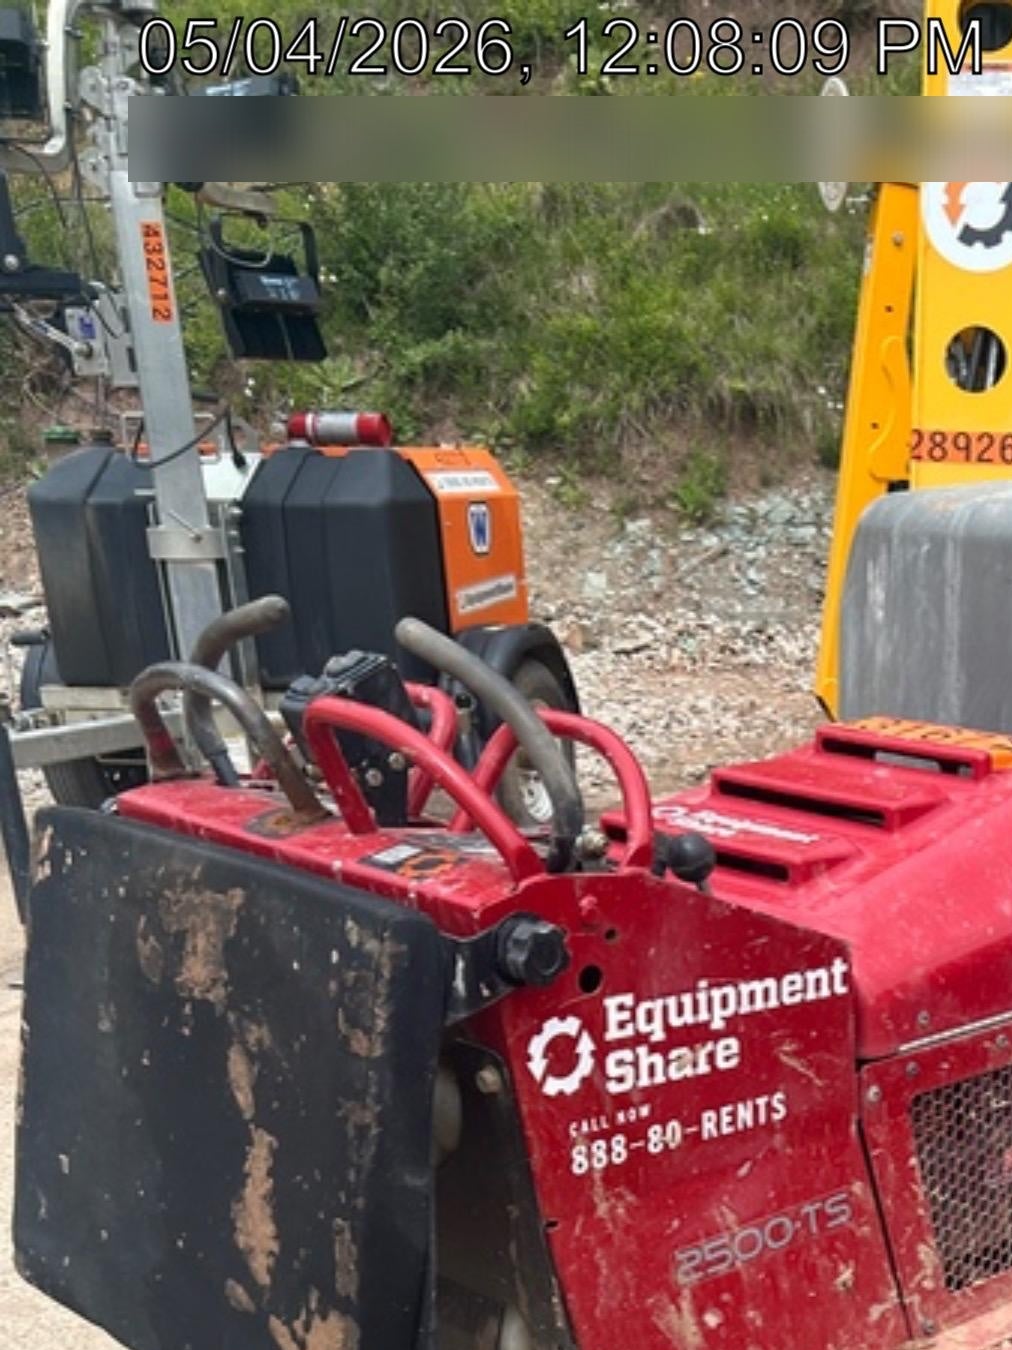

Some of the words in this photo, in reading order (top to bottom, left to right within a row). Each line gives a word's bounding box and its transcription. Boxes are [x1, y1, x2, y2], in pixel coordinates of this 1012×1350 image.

[603, 957, 848, 1042] Equipment
[604, 1036, 740, 1094] Share
[568, 1114, 610, 1139] CALL
[616, 1103, 652, 1125] NOW
[570, 1091, 788, 1175] 888-80-RENTS
